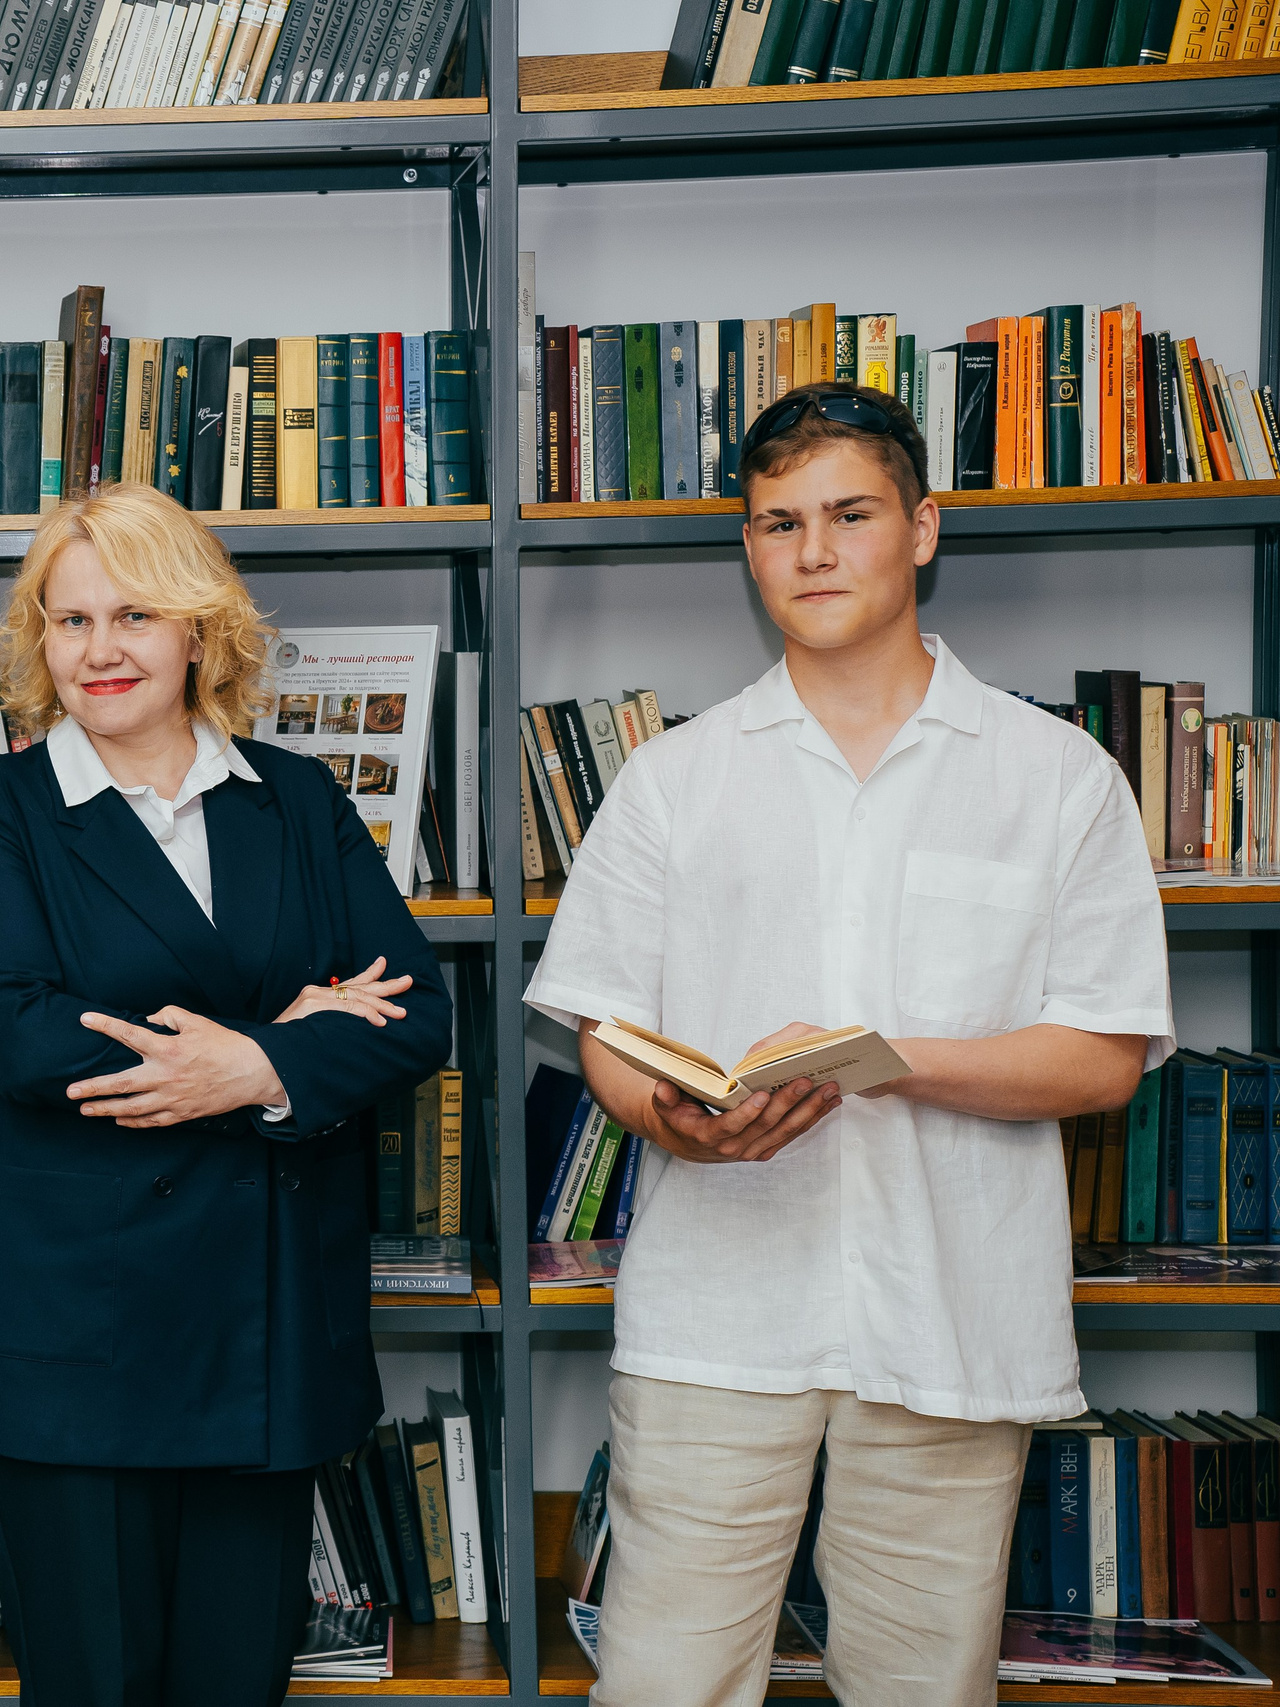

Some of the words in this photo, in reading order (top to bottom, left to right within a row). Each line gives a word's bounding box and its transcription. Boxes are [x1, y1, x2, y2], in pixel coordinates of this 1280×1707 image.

[66, 0, 96, 73] МОПАССАН
[275, 1, 306, 71] ВАШИНГТОН
[320, 1, 349, 59] ПУАНКАРЕ
[362, 0, 392, 64] БРУСИЛОВ
[712, 8, 725, 34] АННА
[24, 19, 48, 70] БЕХТЕРЕВ
[41, 17, 68, 74] ПАГАНИНИ
[339, 26, 359, 70] АЛЕКСАНДР
[381, 26, 406, 71] ЖОРЖ
[406, 22, 427, 64] ДЖОН
[425, 22, 447, 66] ЛЕОНАРДО
[757, 330, 765, 349] ЧАС
[1059, 318, 1073, 362] Распутин
[1087, 343, 1096, 363] Перо
[97, 364, 106, 395] БУНИН
[352, 358, 376, 366] КУПРИН
[535, 346, 543, 386] СЧАСТЛИВЫХ
[581, 355, 590, 390] сердца
[728, 351, 736, 375] ПОЭЗИИ
[757, 354, 765, 399] ДОБРЫЙ
[1060, 364, 1071, 374] В.
[1125, 361, 1135, 397] РОМАН
[570, 366, 579, 402] квартиры
[727, 376, 736, 410] ИРКУТСКОЙ
[916, 370, 924, 425] Аверченко
[1002, 382, 1010, 410] Л.Жаколио
[172, 379, 182, 432] ПАУСТОВСКИЙ
[230, 392, 243, 447] ЕВТУШЕНКО
[408, 381, 423, 432] БАЙКАЛ
[581, 392, 590, 437] Память
[216, 421, 223, 436] 5
[549, 411, 558, 442] КАТАЕВ
[728, 411, 737, 444] АНТОЛОГИЯ
[1087, 427, 1096, 459] Сергеев
[1125, 398, 1138, 470] АВАНТЮРНЫЙ
[229, 448, 240, 467] ЕВГ.
[536, 449, 544, 471] ДЕСЯТЬ
[549, 446, 558, 492] ВАЛЕНТИН
[583, 441, 592, 488] ГАГАРИНА
[703, 442, 713, 489] ВИКТОР
[936, 434, 944, 485] Государственный
[1087, 462, 1095, 483] Марк
[330, 480, 337, 489] 3
[364, 479, 371, 487] 2
[301, 654, 319, 665] Мы
[327, 655, 364, 666] лучший
[366, 654, 414, 666] ресторан
[623, 710, 638, 749] ИНАНИЯХ
[646, 696, 661, 733] СКОМ
[463, 748, 473, 787] РОЗОВА
[573, 741, 583, 759] работа
[578, 761, 586, 771] Вас
[1190, 746, 1198, 789] любовники
[1181, 745, 1191, 812] Необыкновенные
[463, 790, 473, 813] СВЕТ
[383, 1136, 397, 1151] 20
[550, 1160, 567, 1196] МОЛОДОСТЬ
[561, 1131, 577, 1159] ГЕНРИХА
[590, 1137, 618, 1196] А.СЕРАФИМОВИЧ
[624, 1156, 635, 1192] МОЛОДОСТЬ
[386, 1279, 449, 1289] ИРКУТСКИЙ
[453, 1427, 465, 1454] первая
[456, 1458, 465, 1482] Книга
[1060, 1443, 1077, 1482] ТВЕН
[1061, 1485, 1078, 1534] МАРК
[312, 1538, 326, 1561] 2008
[460, 1531, 475, 1569] Казанцев
[465, 1573, 475, 1603] Алексей
[1095, 1561, 1105, 1596] МАРК
[1105, 1556, 1114, 1589] ТВЕН
[360, 1583, 370, 1600] 2002
